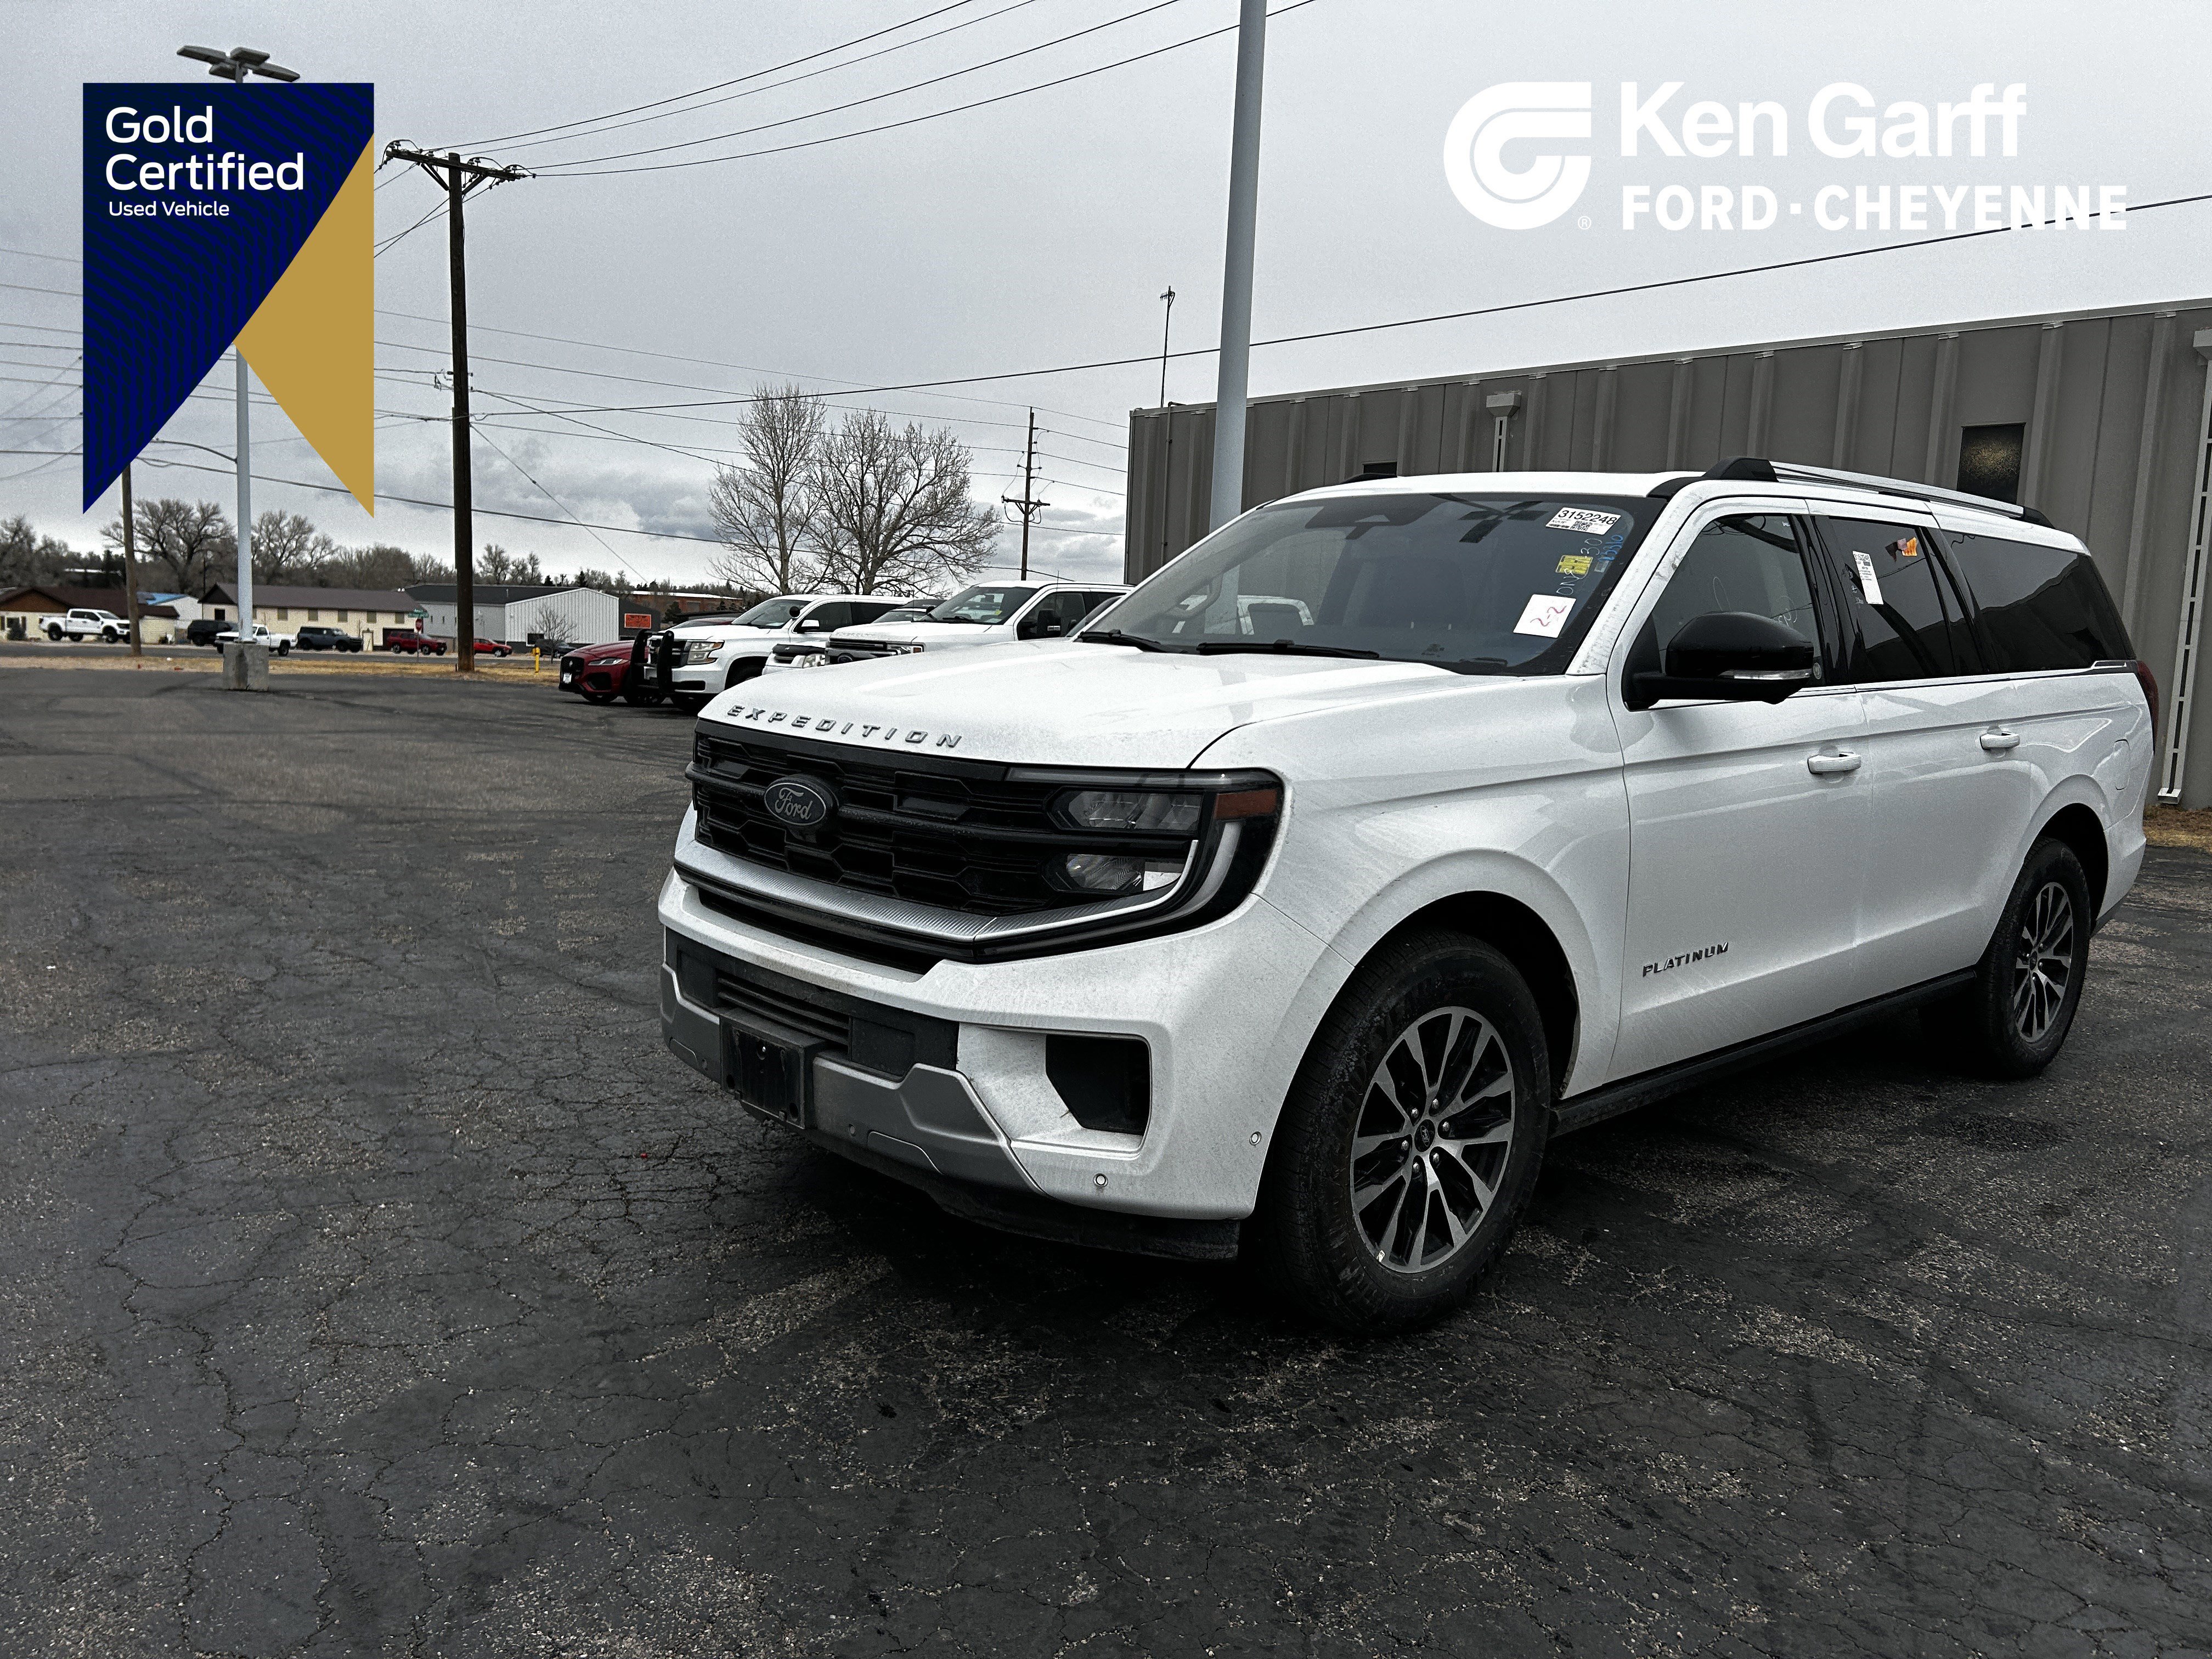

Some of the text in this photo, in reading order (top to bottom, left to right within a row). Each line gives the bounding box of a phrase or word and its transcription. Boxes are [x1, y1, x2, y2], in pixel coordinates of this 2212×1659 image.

[1558, 510, 1617, 525] 3152248
[727, 705, 962, 748] EXPEDITION
[775, 787, 814, 821] Ford
[1643, 942, 1729, 977] PLATINUM
